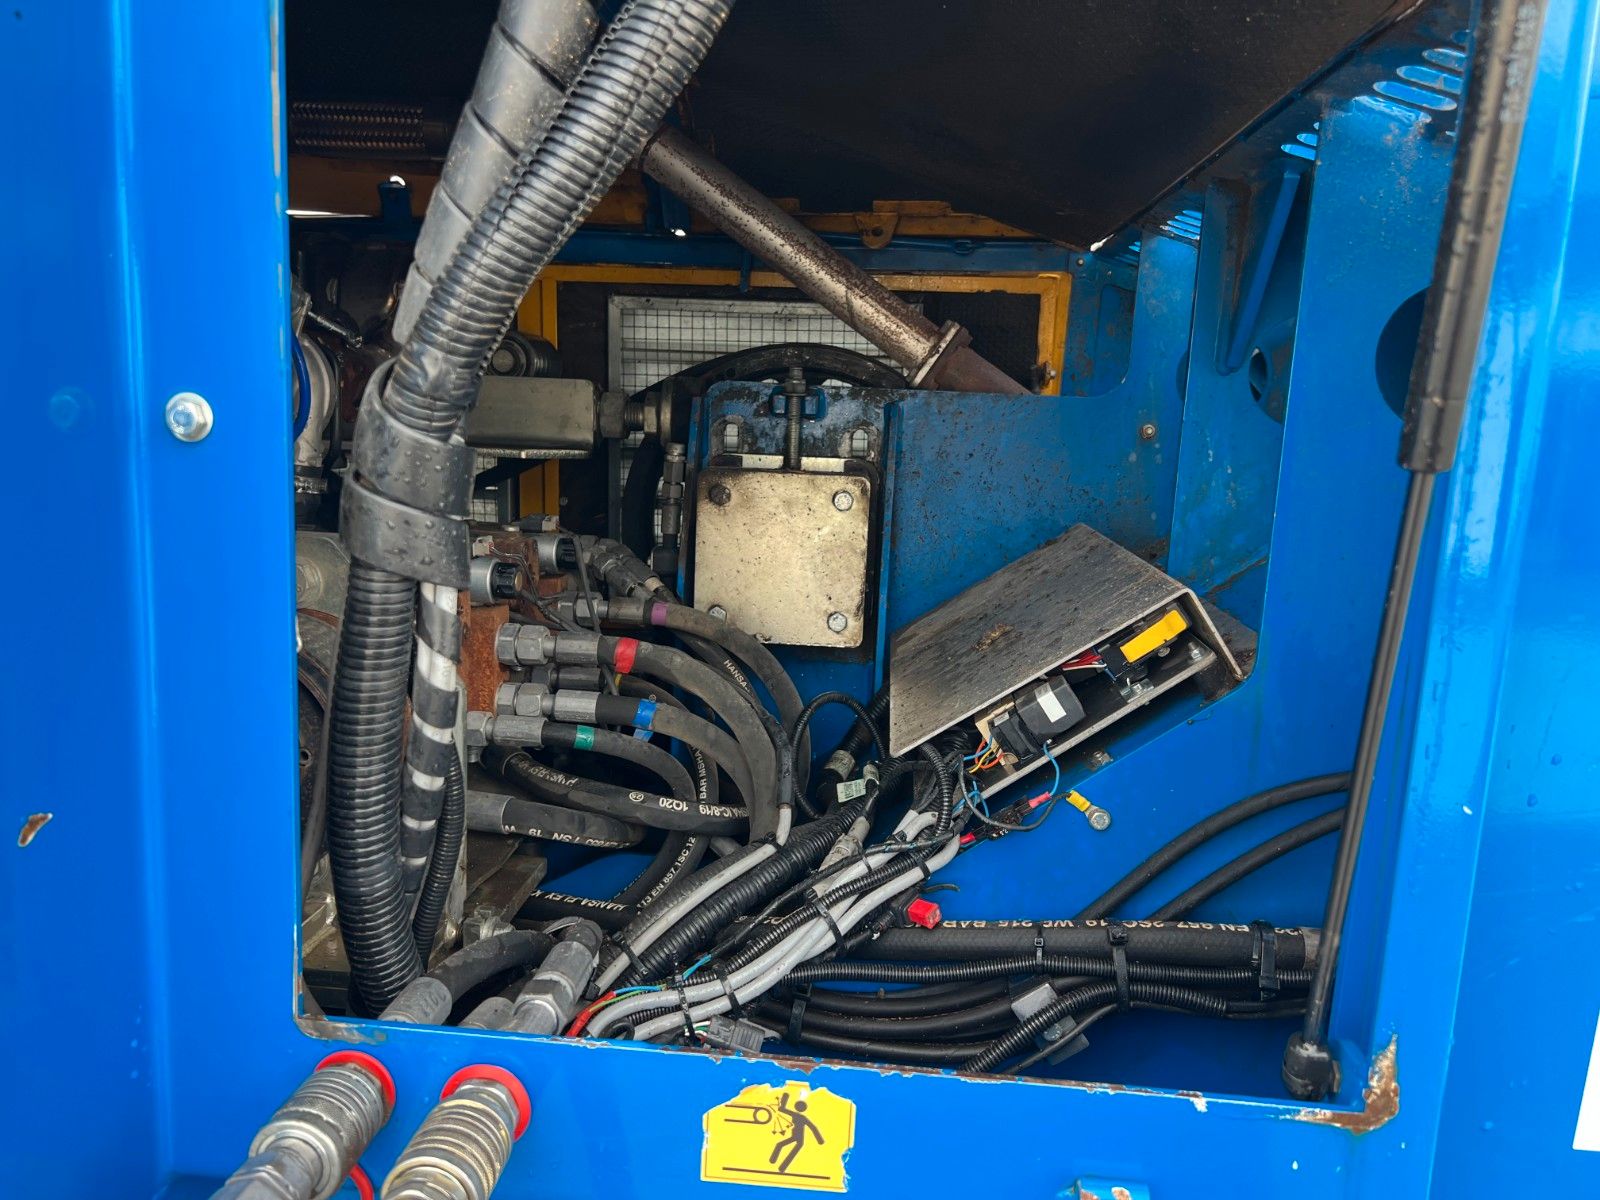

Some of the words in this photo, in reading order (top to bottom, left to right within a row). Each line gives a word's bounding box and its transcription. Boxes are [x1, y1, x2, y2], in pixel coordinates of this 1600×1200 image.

[699, 779, 707, 798] BAR
[659, 797, 688, 812] 1Q20
[651, 884, 664, 896] EN
[662, 868, 676, 884] 857
[675, 849, 689, 867] 1SC
[686, 837, 697, 848] 12
